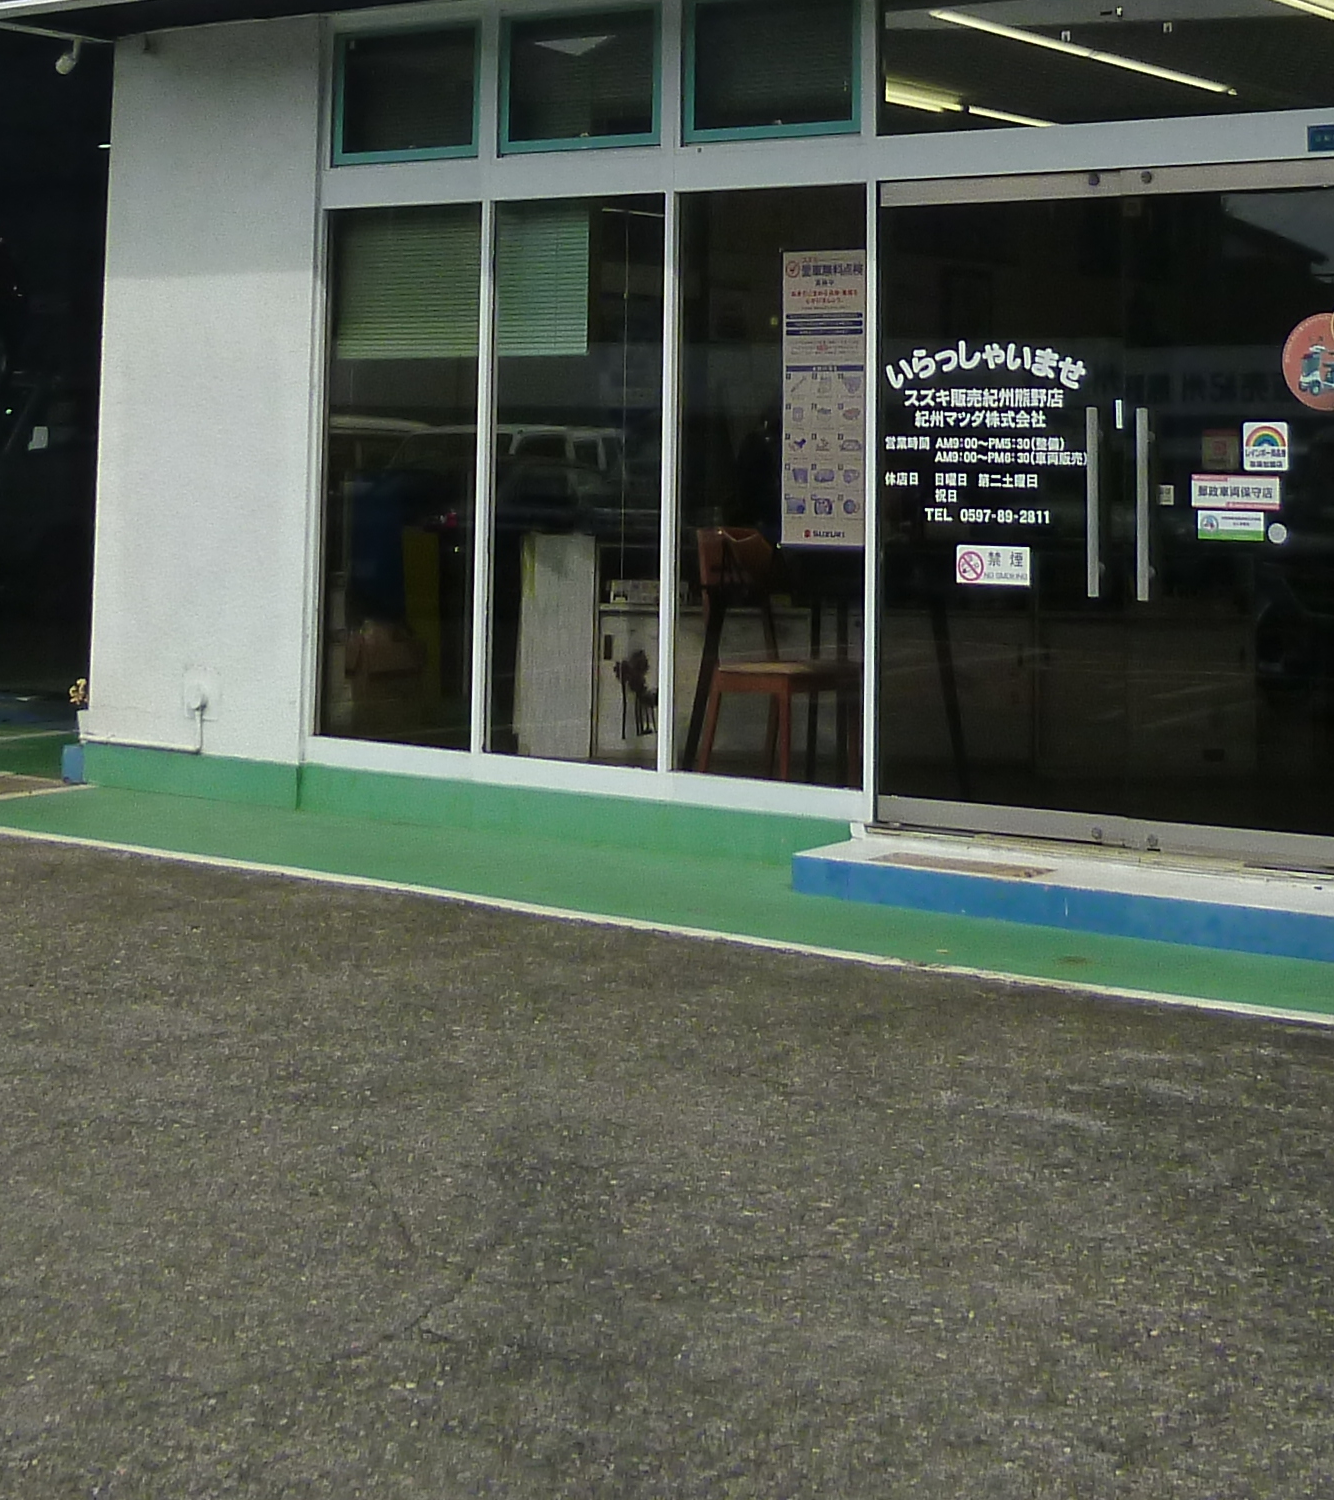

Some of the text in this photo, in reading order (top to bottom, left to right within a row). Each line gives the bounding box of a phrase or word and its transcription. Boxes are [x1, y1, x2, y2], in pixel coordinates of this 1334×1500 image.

[885, 340, 1087, 389] いらっしゃいませ
[903, 387, 1064, 408] スズキ販売紀州熊野店
[914, 410, 1047, 429] 紀州マツダ株式会社
[884, 436, 930, 450] 営業時間
[884, 471, 1039, 489] 休店日 日曜日 第二土曜日
[934, 488, 958, 503] 祝日
[924, 507, 1051, 525] TEL 0597-89-2811
[987, 550, 1024, 568] 禁煙
